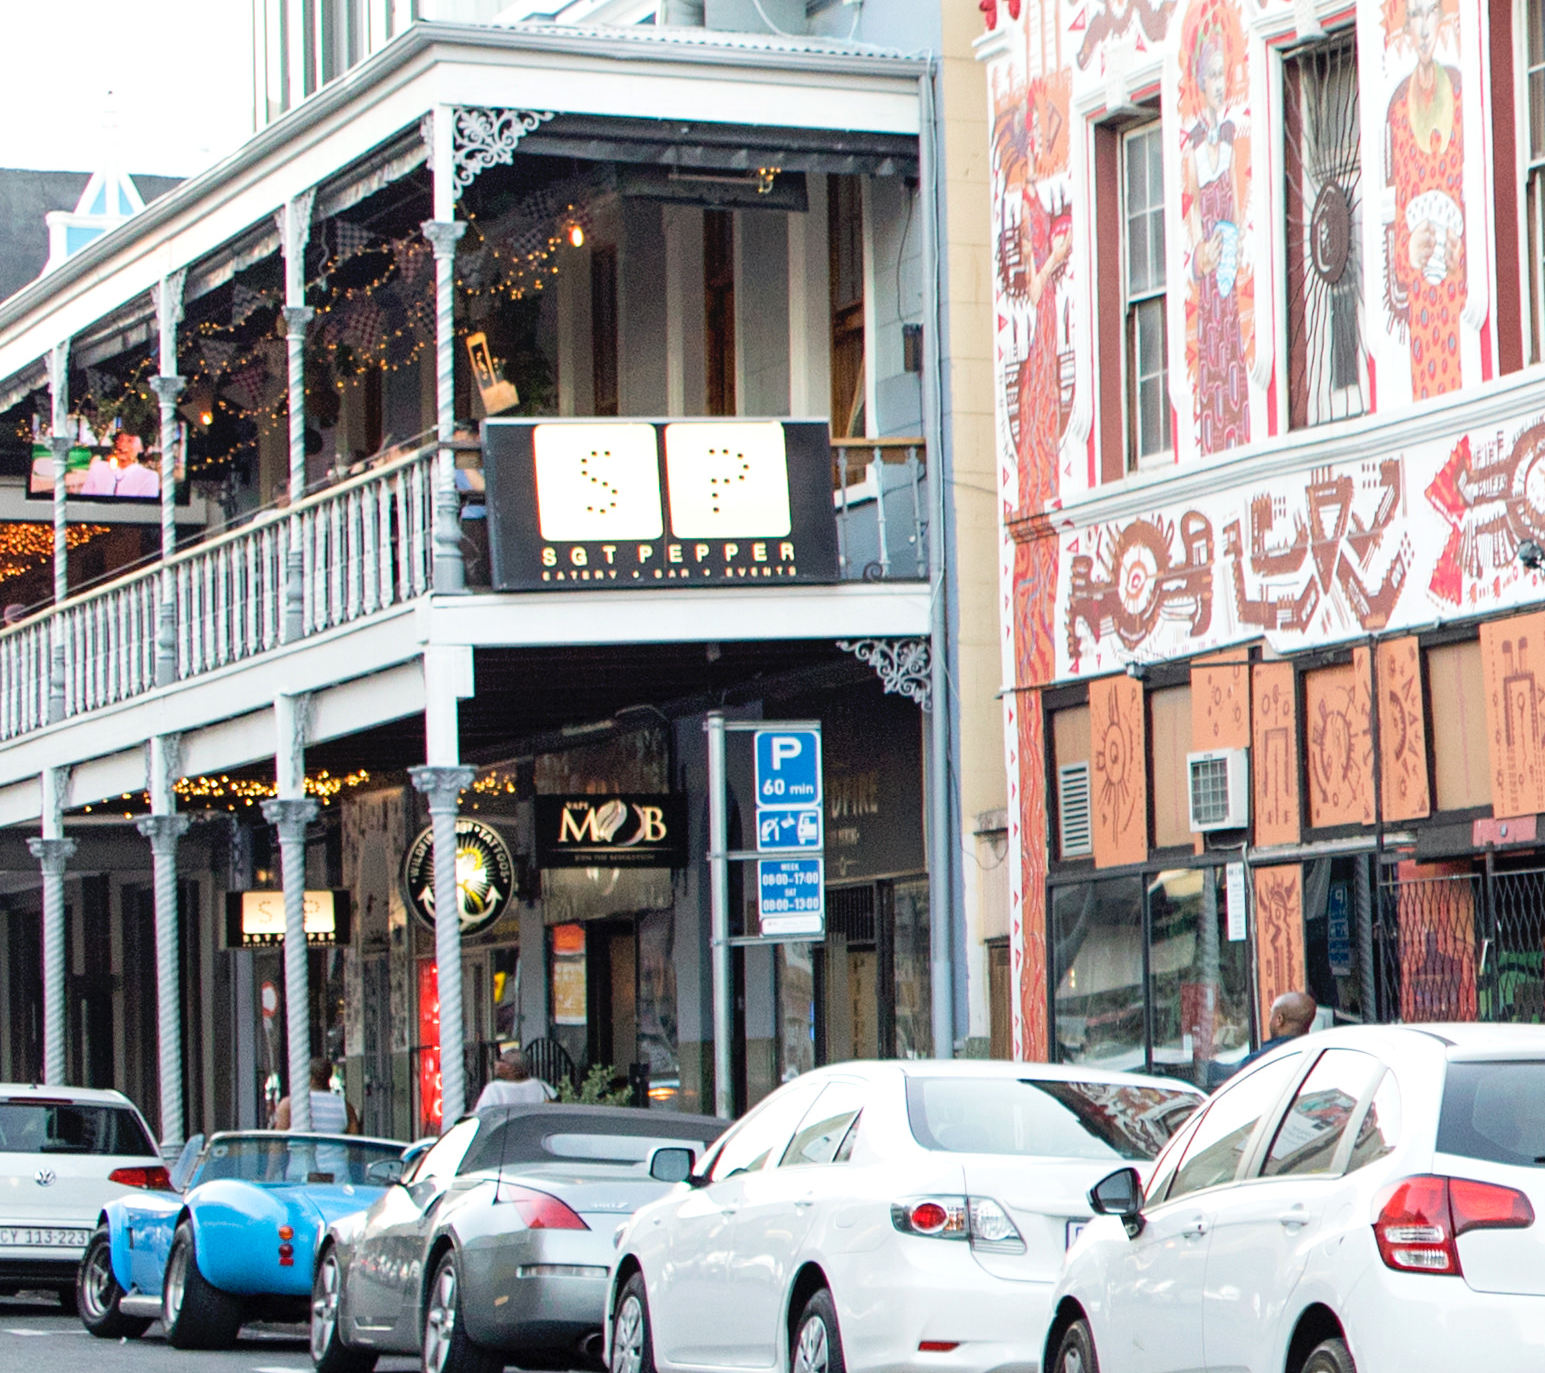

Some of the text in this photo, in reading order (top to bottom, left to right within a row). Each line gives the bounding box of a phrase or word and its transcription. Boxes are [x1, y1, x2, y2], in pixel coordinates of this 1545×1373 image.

[541, 542, 796, 567] SGT PEPPER
[771, 737, 802, 770] P
[762, 779, 814, 795] 60 min
[0, 1230, 85, 1244] CY 113-223
